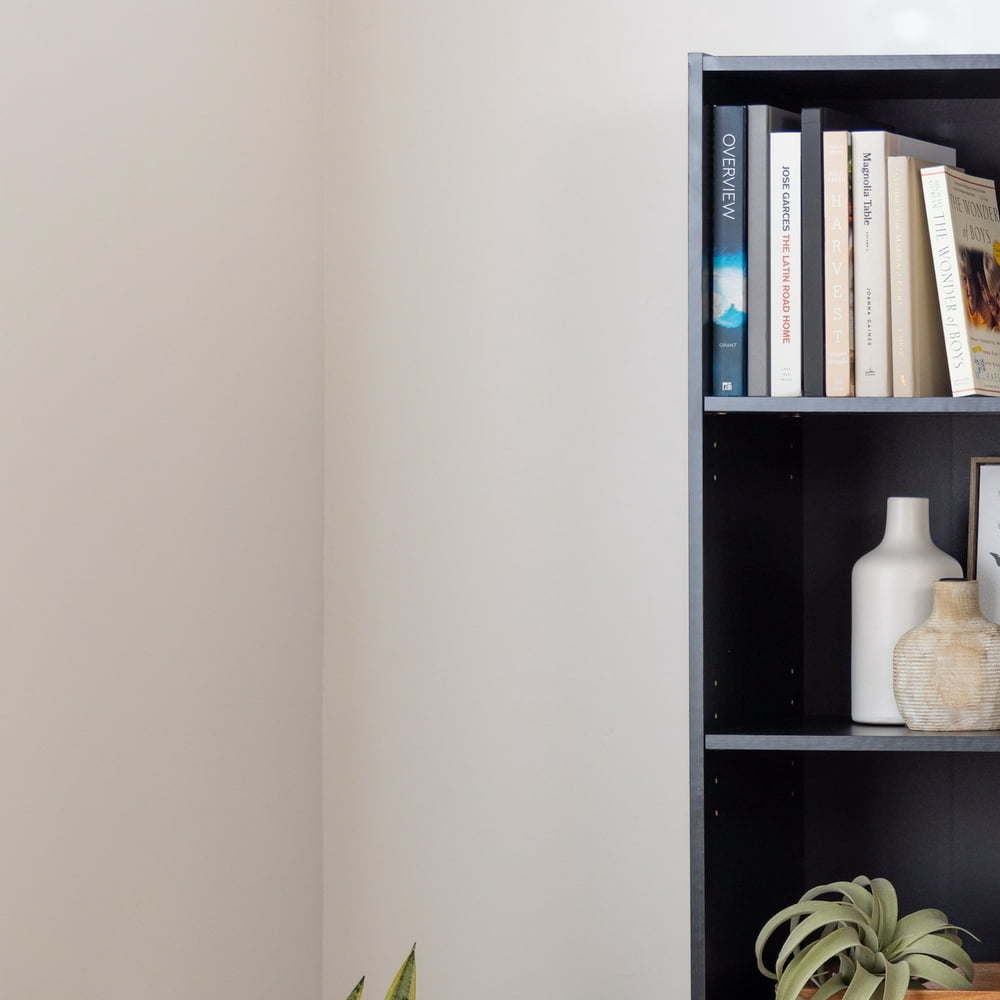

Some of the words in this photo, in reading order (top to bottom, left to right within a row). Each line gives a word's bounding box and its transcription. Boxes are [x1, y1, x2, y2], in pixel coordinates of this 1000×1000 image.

[722, 133, 736, 220] OVERVIEW
[782, 166, 790, 190] JOSE
[862, 152, 872, 197] Magnolia
[782, 192, 790, 232] GARCES
[863, 200, 872, 226] Table
[932, 213, 947, 240] THE
[782, 234, 790, 253] THE
[782, 255, 790, 282] LATIN
[938, 245, 957, 313] WONDER
[782, 285, 791, 313] ROAD
[782, 315, 791, 344] HOME
[948, 330, 964, 370] BOYS
